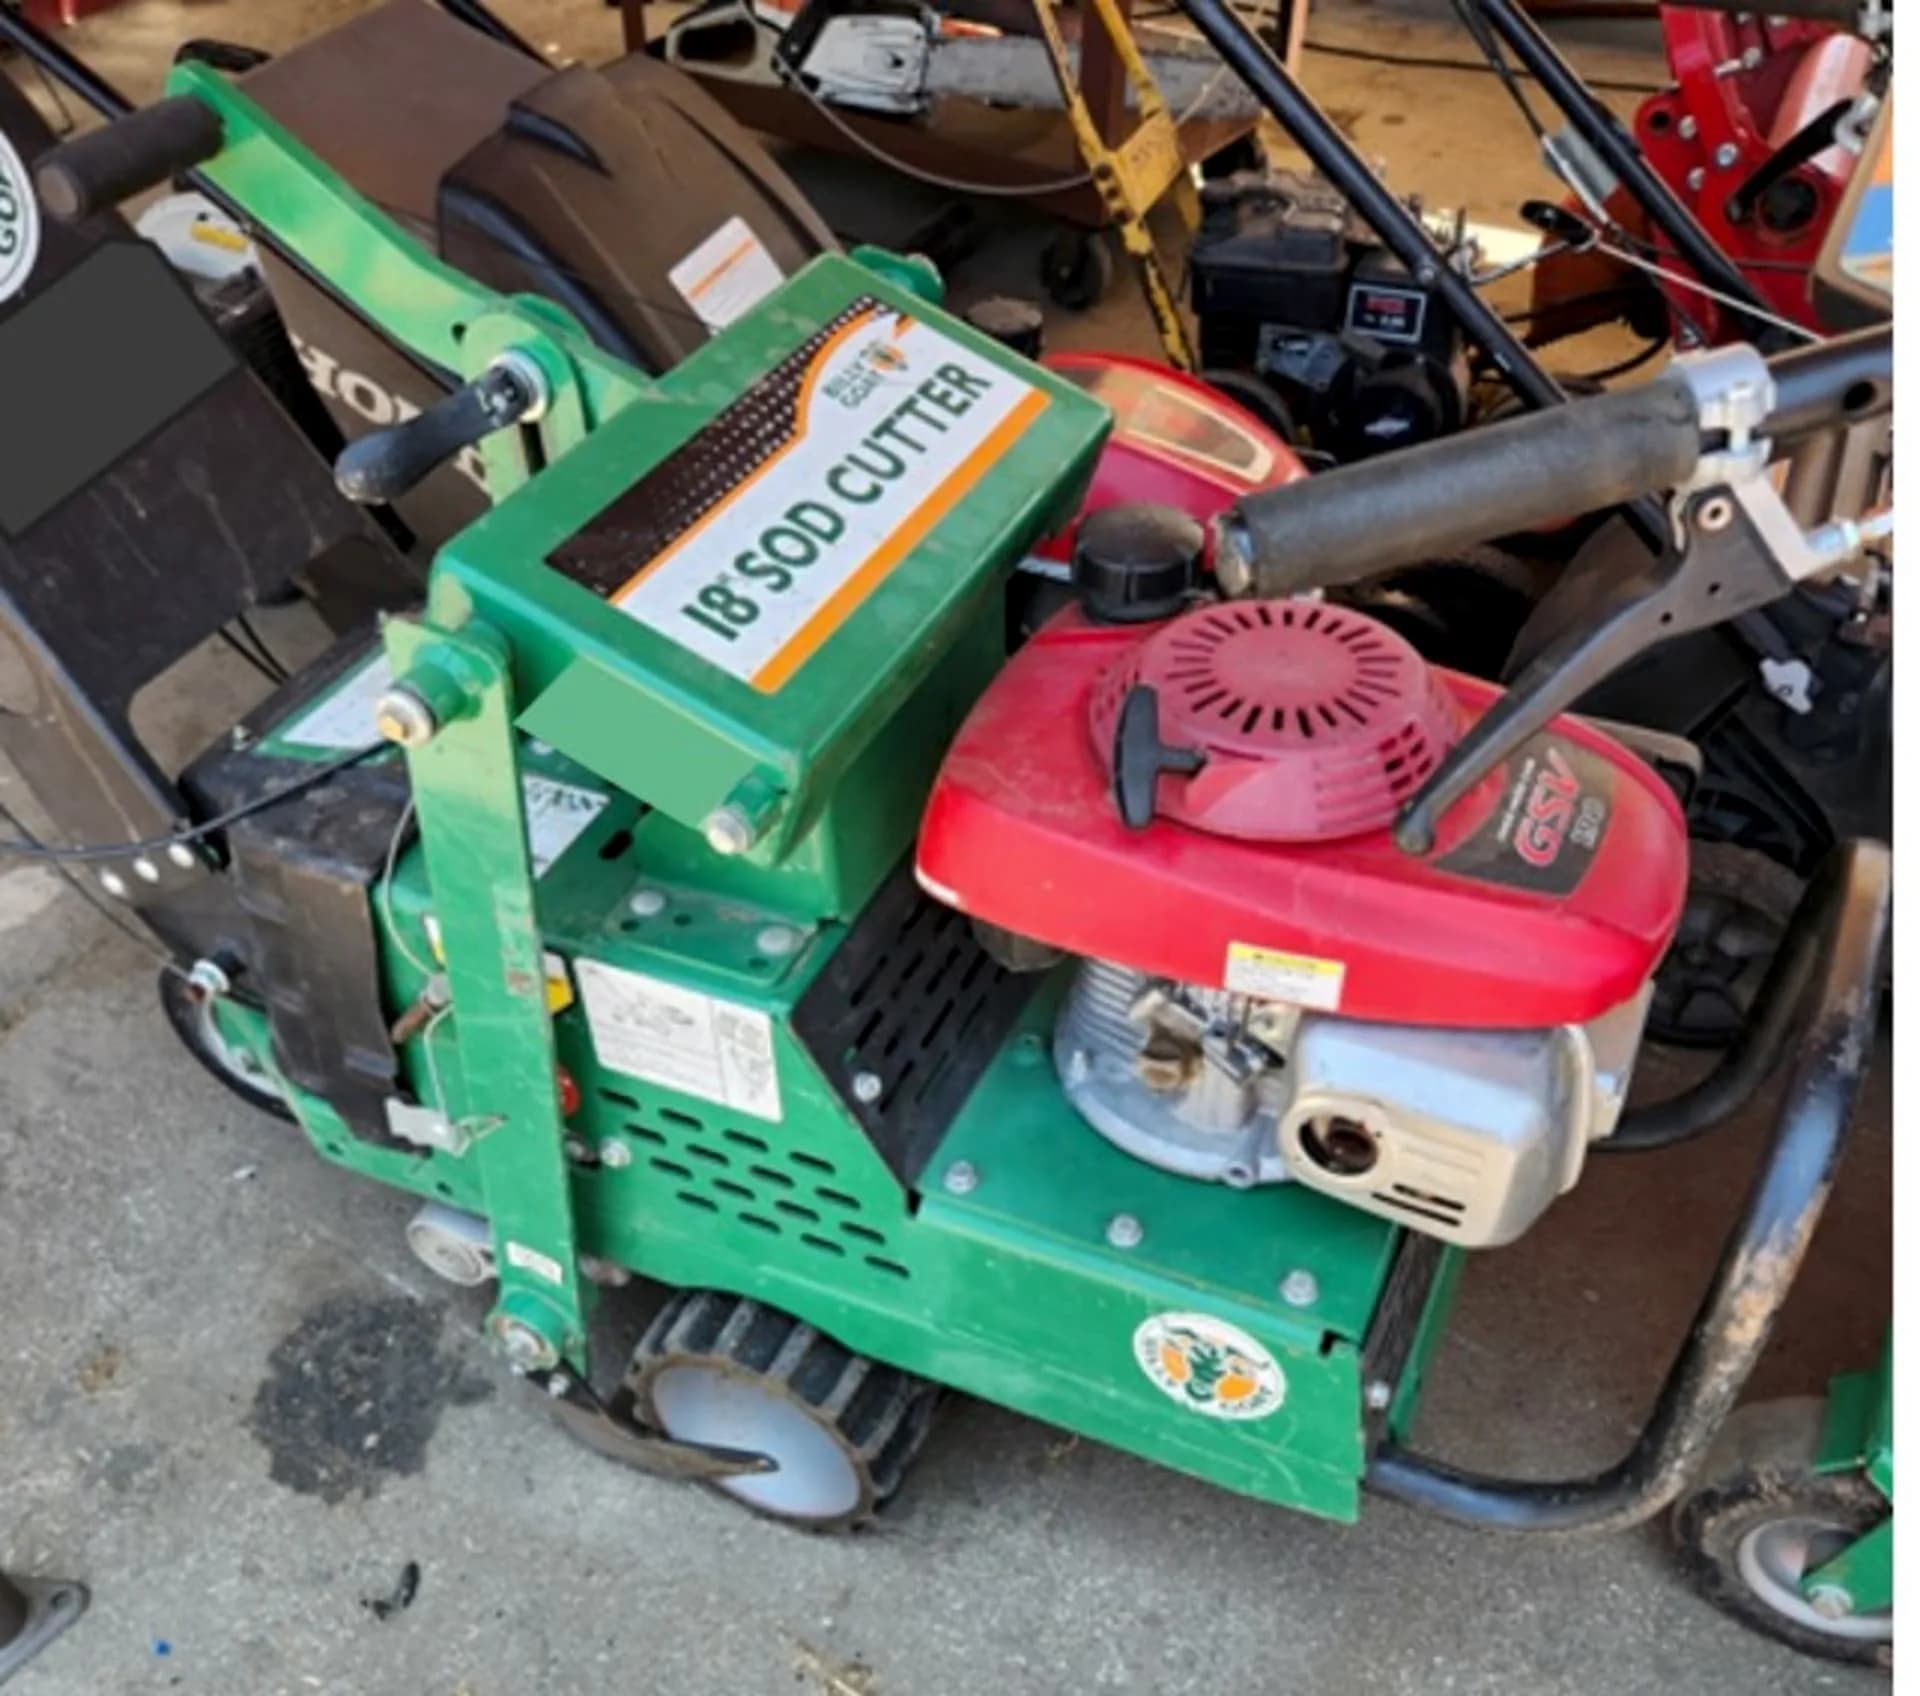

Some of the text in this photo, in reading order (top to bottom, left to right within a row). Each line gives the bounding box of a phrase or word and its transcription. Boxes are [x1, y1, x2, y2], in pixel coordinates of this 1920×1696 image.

[734, 501, 845, 592] SOD
[826, 362, 992, 504] CUTTER
[1515, 748, 1580, 867] GSV
